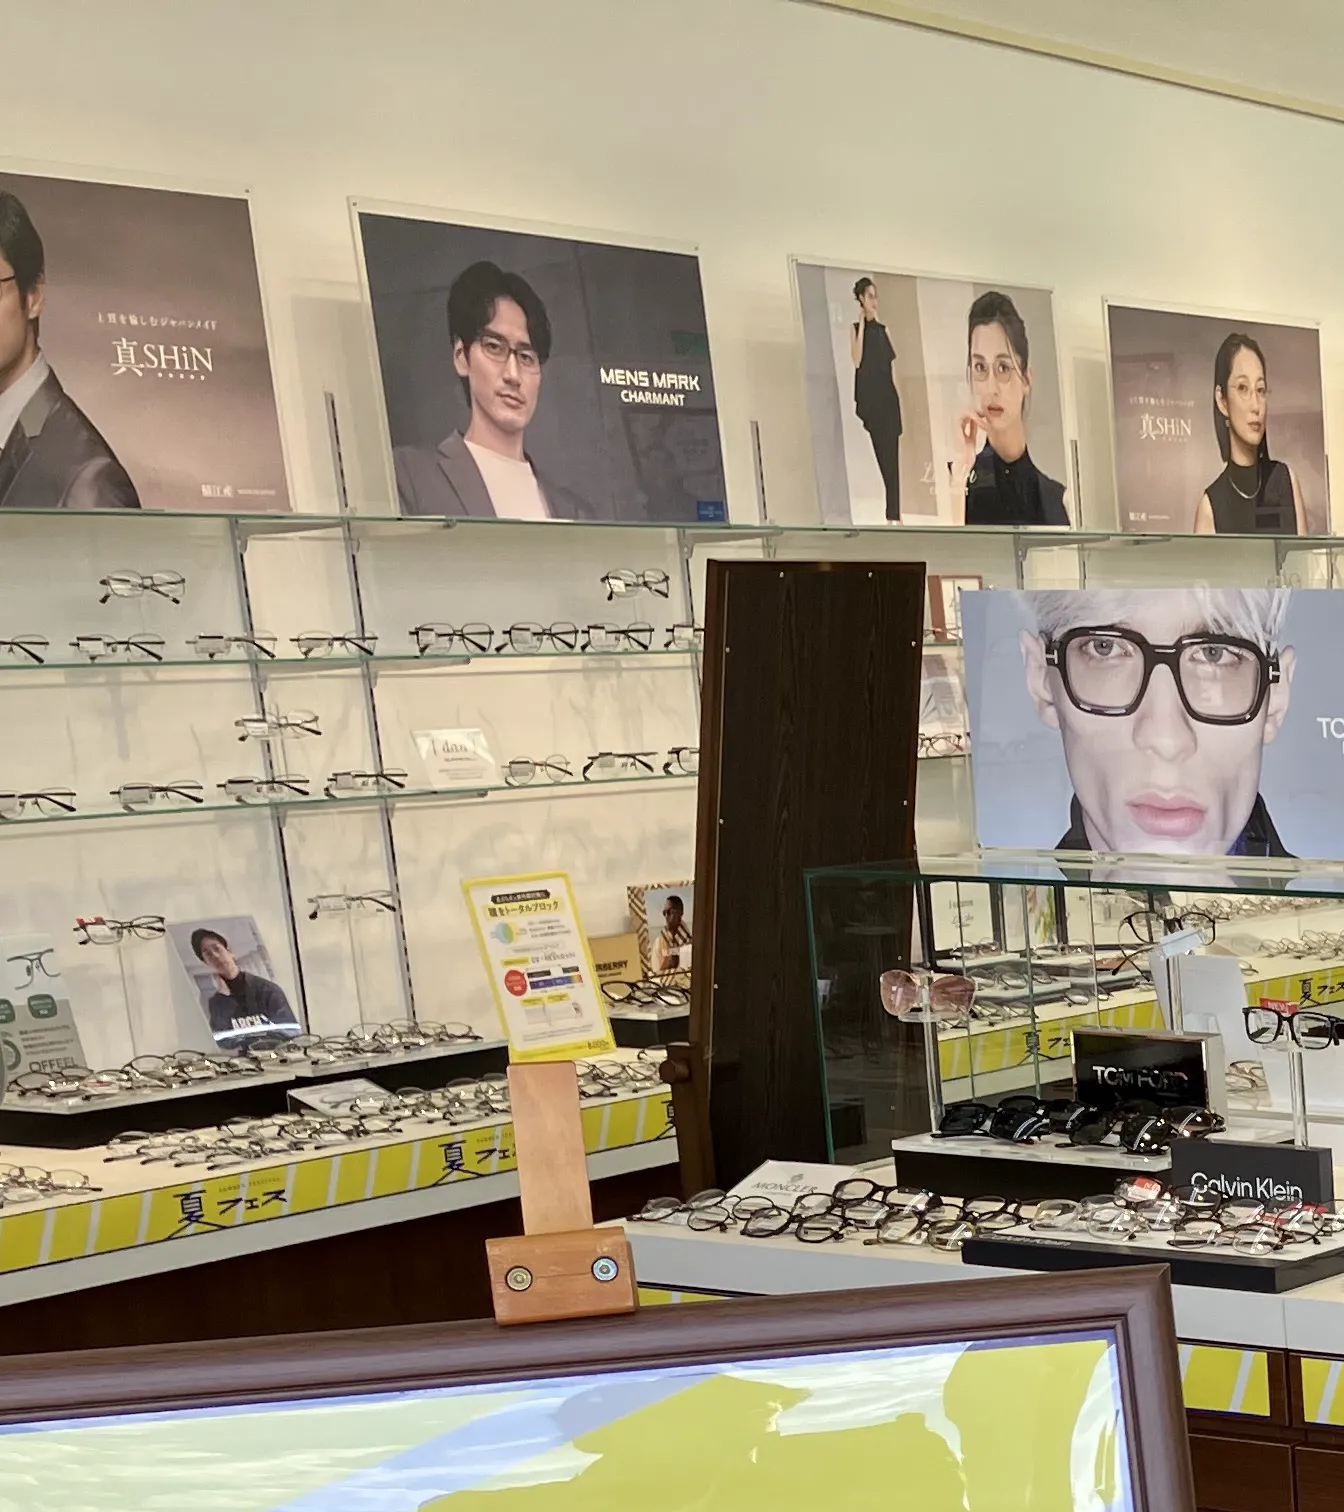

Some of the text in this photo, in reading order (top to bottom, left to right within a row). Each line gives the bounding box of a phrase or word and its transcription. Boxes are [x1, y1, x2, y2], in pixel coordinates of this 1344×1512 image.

[600, 368, 701, 391] MENS MARK
[621, 390, 685, 406] CHARMANT
[1093, 1066, 1134, 1085] TOM
[433, 1140, 516, 1184] 夏フェ
[1191, 1172, 1303, 1201] Calvin Klein
[165, 1188, 288, 1239] 夏フェス
